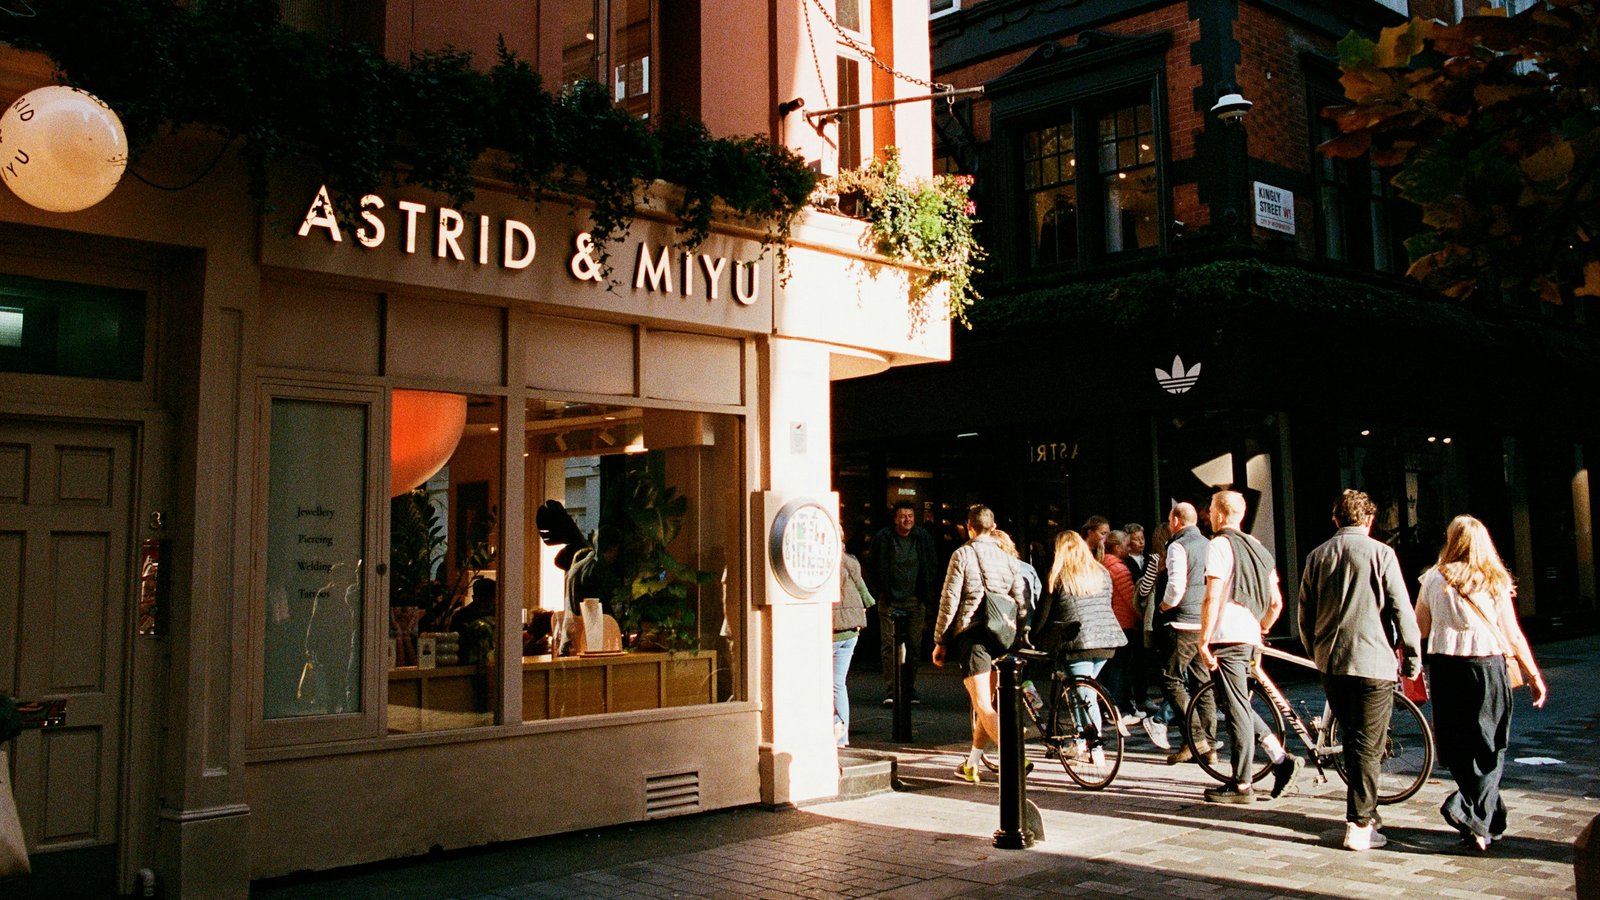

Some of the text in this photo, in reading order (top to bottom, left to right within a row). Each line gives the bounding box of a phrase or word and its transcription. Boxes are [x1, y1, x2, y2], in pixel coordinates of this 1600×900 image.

[1259, 187, 1281, 203] KINGLY
[1260, 200, 1282, 216] STREET
[297, 184, 760, 306] ASTRID & MIYU
[150, 511, 161, 529] 3
[296, 506, 335, 519] Jewellery
[298, 534, 333, 547] Piercing
[297, 561, 332, 573] Welding
